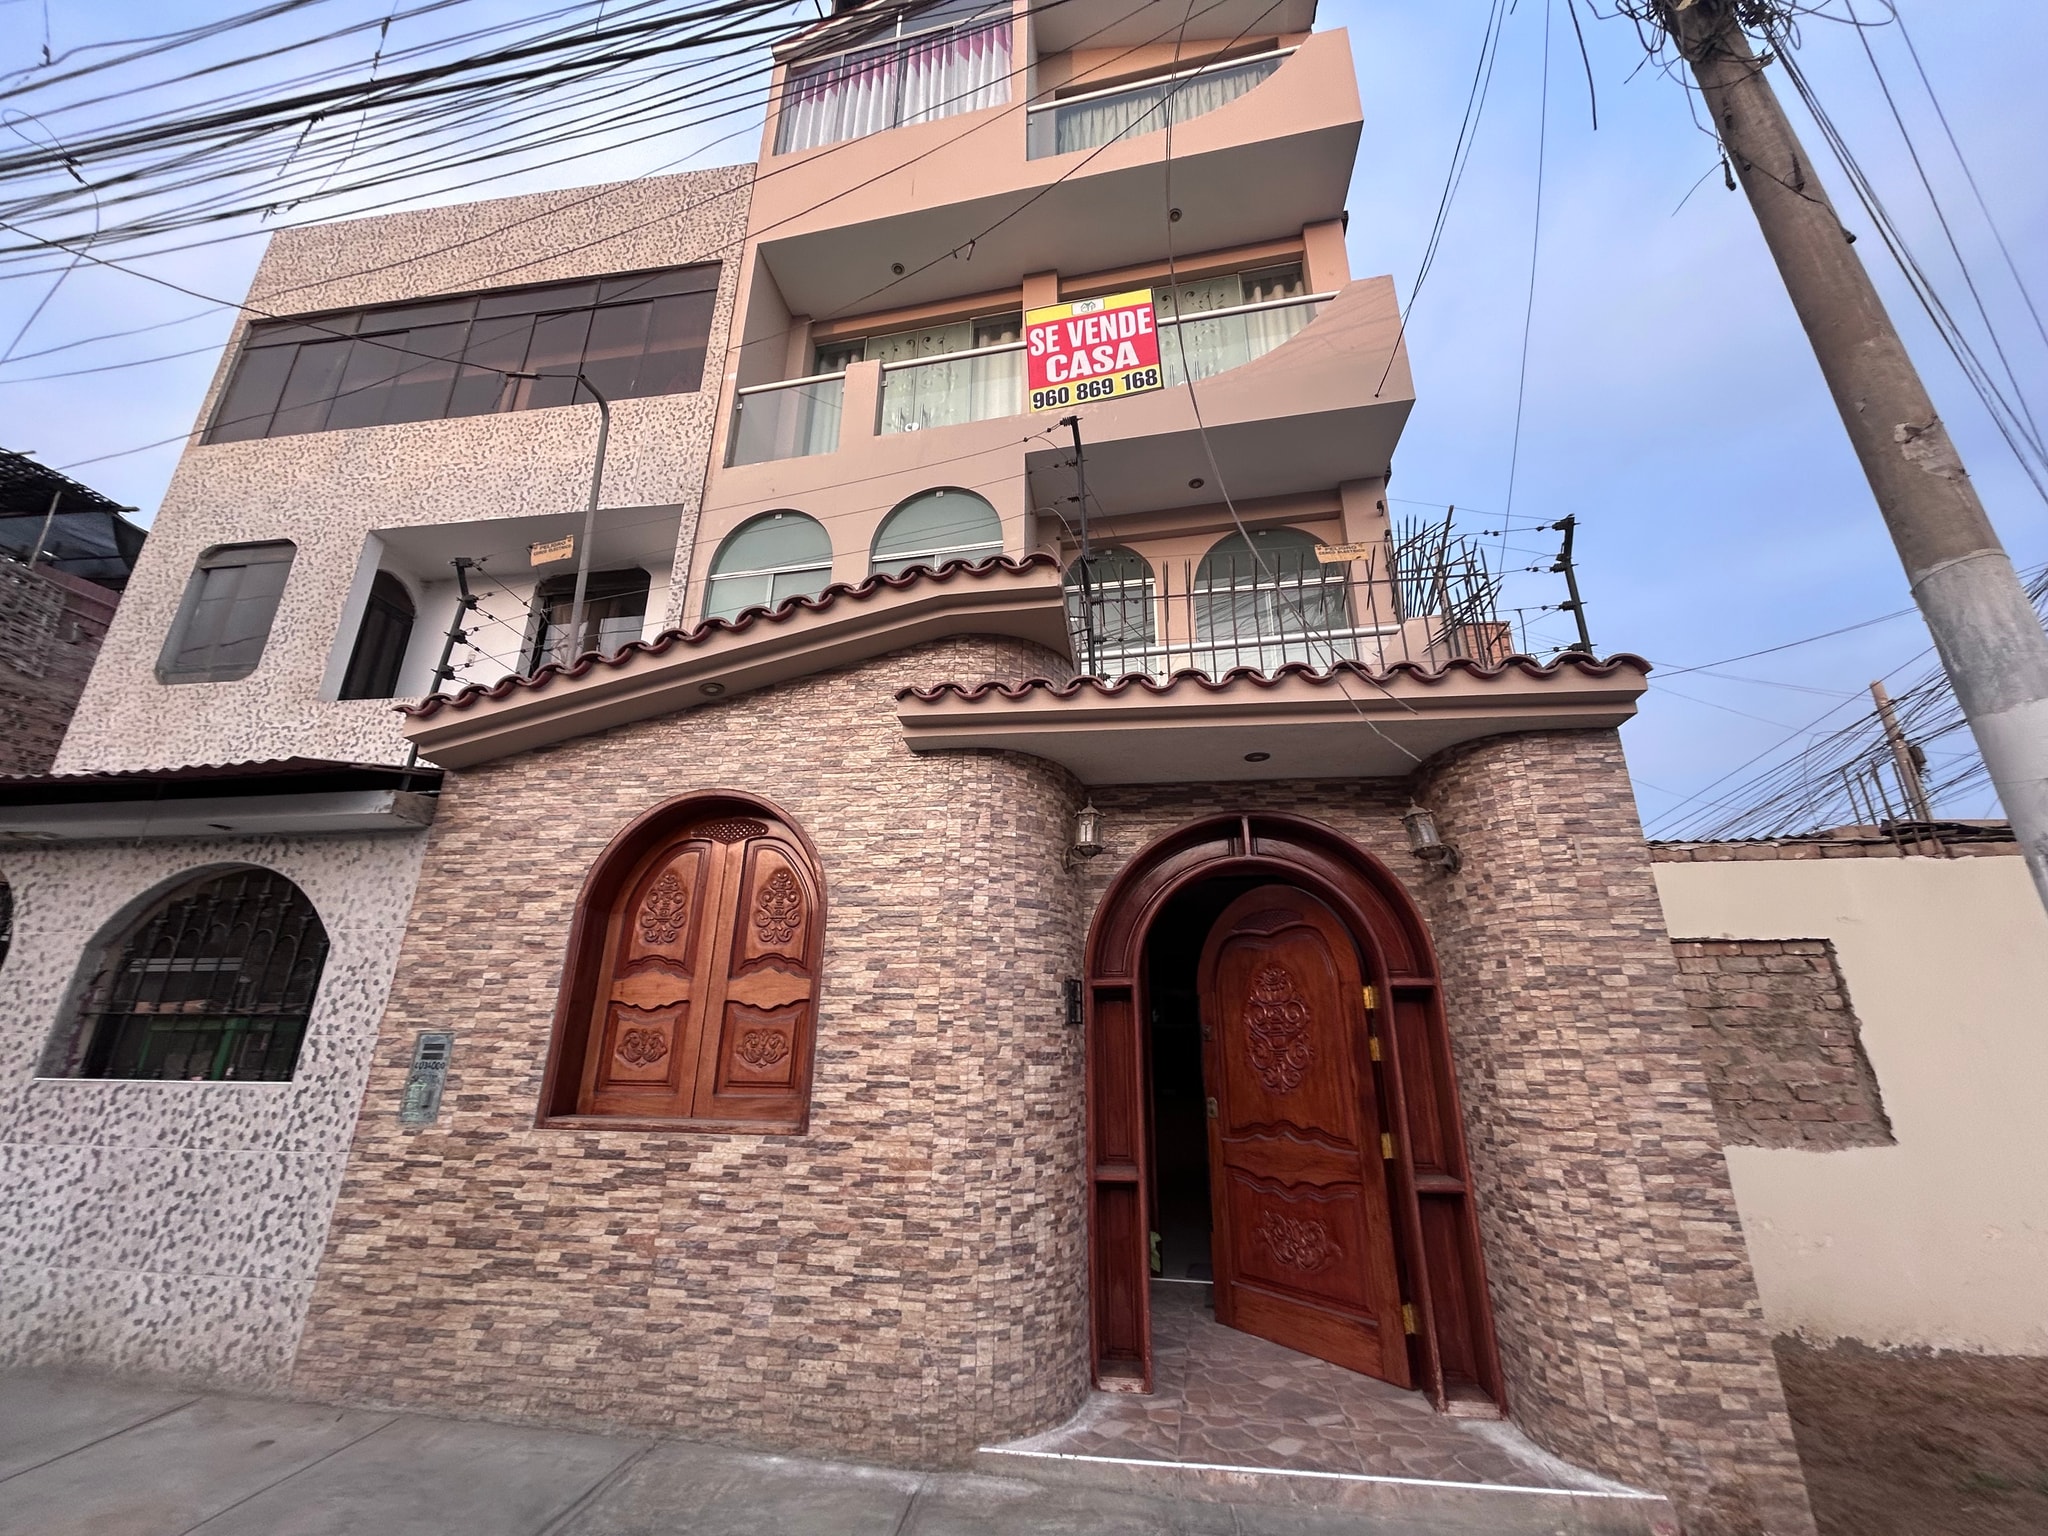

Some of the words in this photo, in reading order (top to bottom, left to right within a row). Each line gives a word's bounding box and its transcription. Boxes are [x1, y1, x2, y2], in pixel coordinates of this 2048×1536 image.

[1029, 324, 1060, 356] SE
[1067, 307, 1152, 348] VENDE
[1046, 341, 1140, 382] CASA
[1033, 387, 1069, 409] 960
[1076, 378, 1113, 400] 869
[1121, 368, 1158, 390] 168
